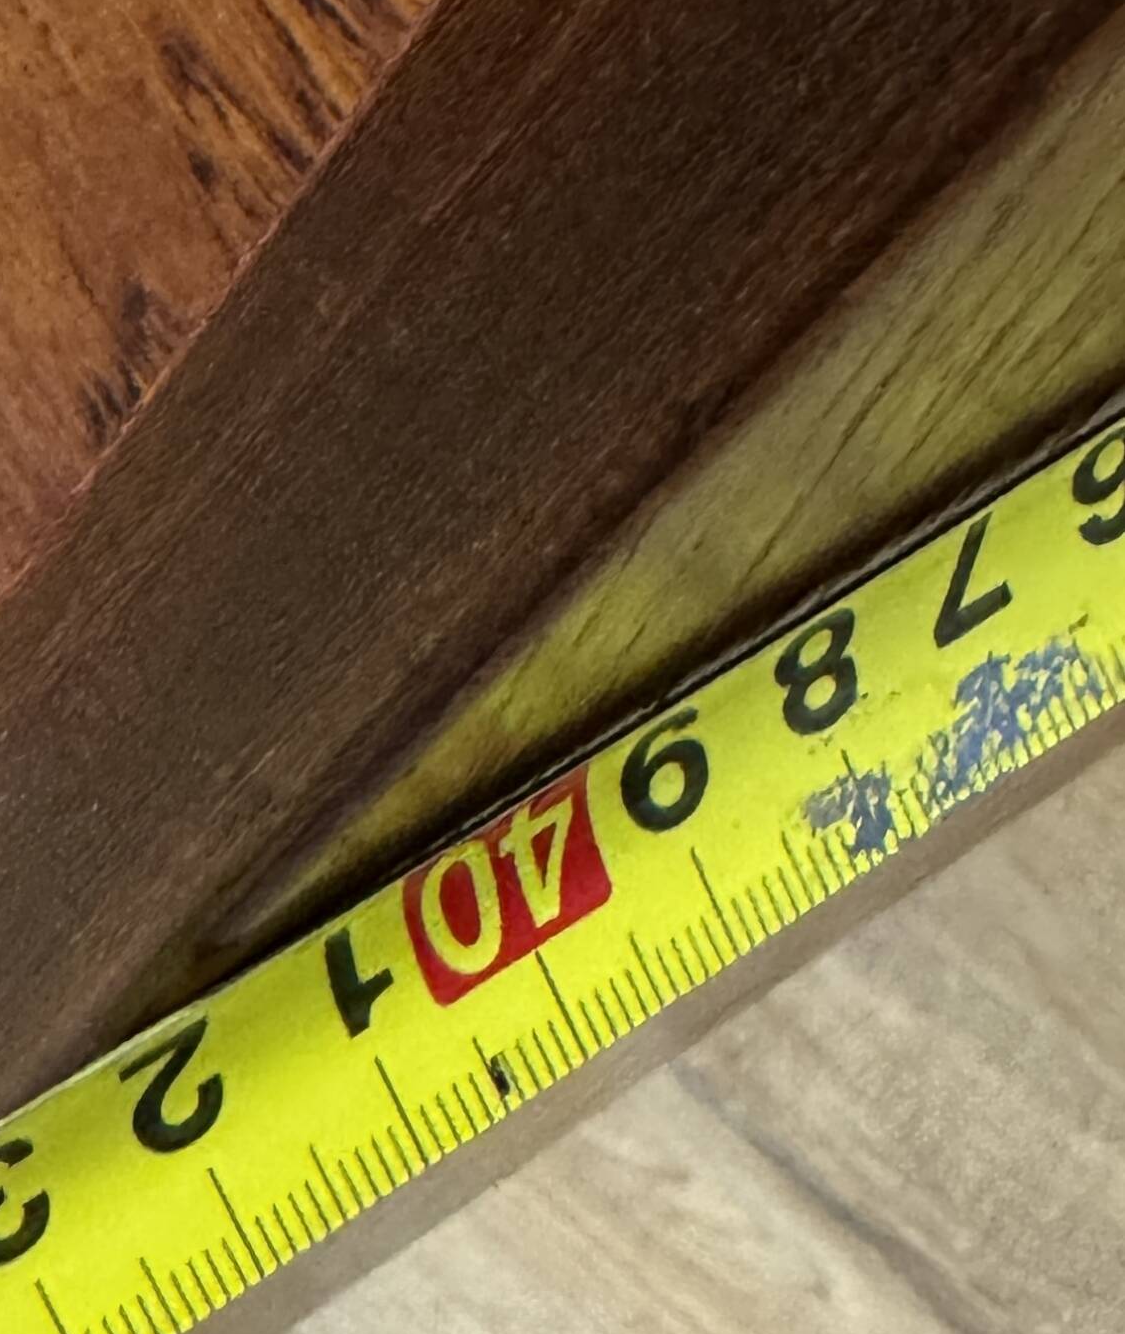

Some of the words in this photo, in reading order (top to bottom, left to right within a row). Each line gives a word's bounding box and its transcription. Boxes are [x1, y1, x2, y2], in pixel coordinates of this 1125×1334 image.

[933, 512, 1013, 648] 7
[774, 607, 858, 735] 8
[620, 707, 709, 833] 9
[419, 794, 578, 975] 40
[326, 928, 393, 1038] 1
[119, 1015, 223, 1154] 2
